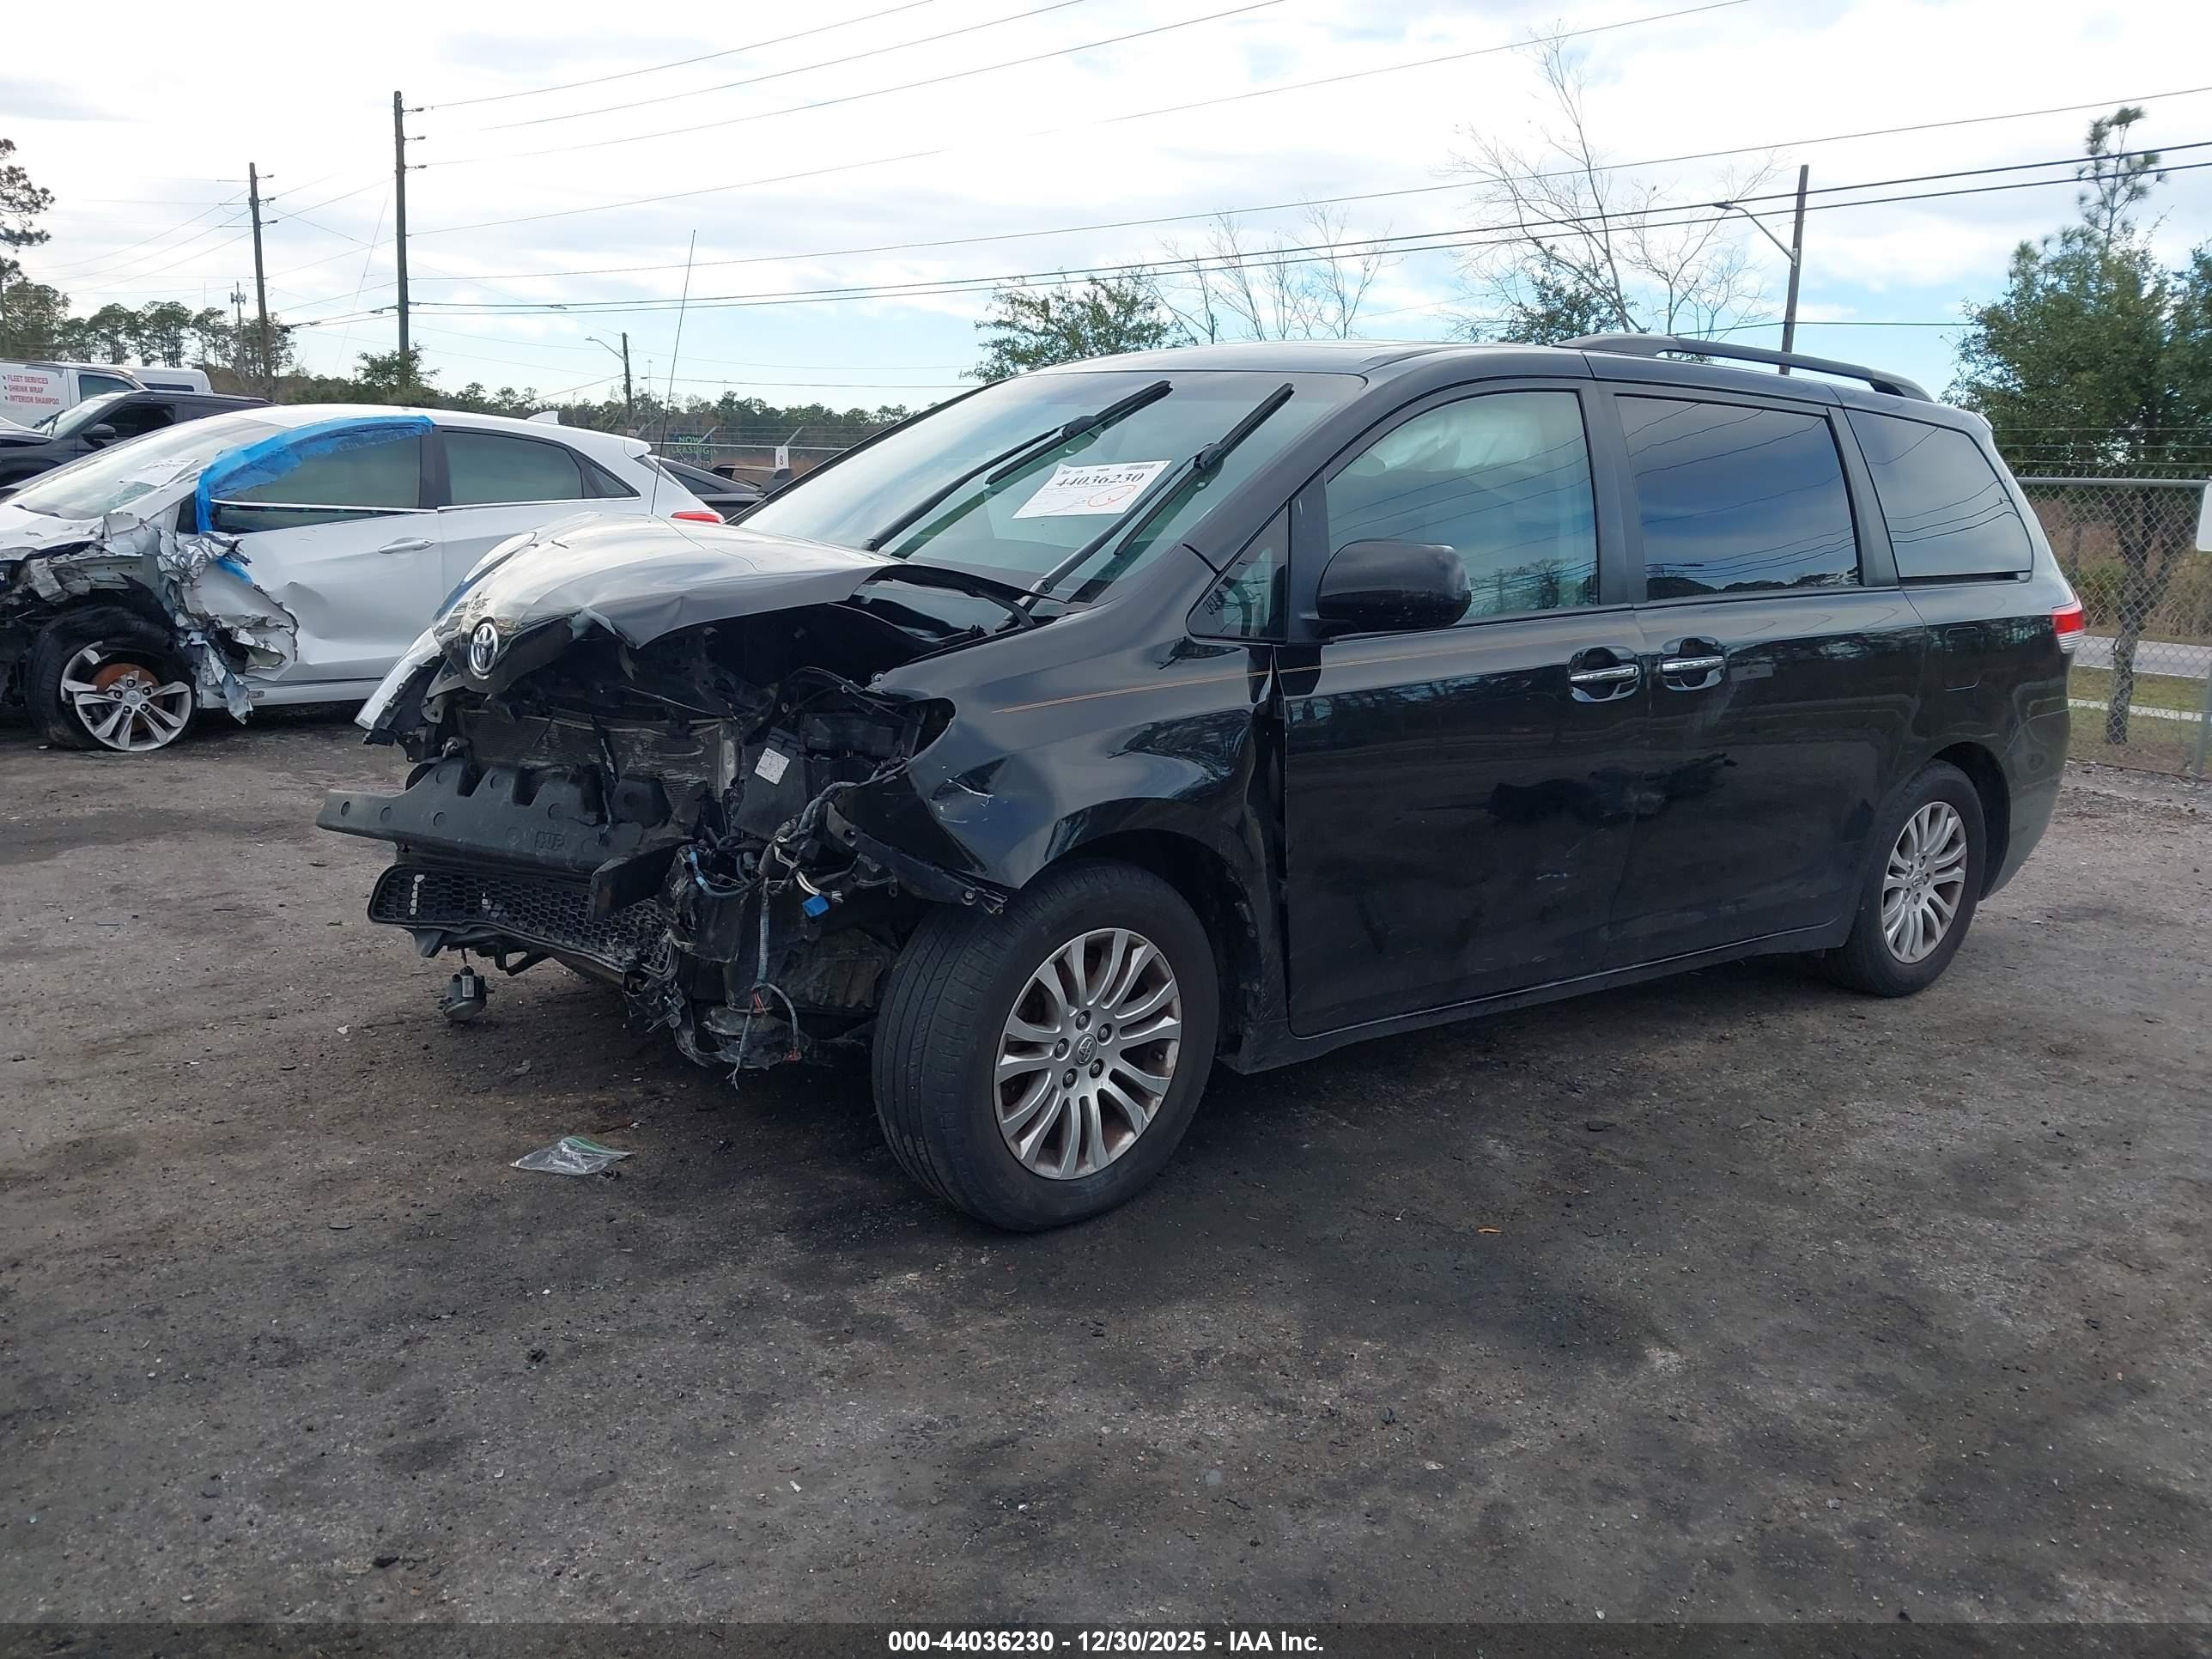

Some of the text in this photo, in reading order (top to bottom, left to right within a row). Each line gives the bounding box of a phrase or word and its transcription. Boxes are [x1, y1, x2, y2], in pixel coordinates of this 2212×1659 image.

[7, 374, 48, 385] FLEET SERVICES
[9, 384, 28, 392] SHRINK
[35, 397, 60, 405] SHAMPOO
[678, 435, 702, 444] NOW
[779, 454, 784, 465] 8
[1055, 472, 1146, 487] 44036230
